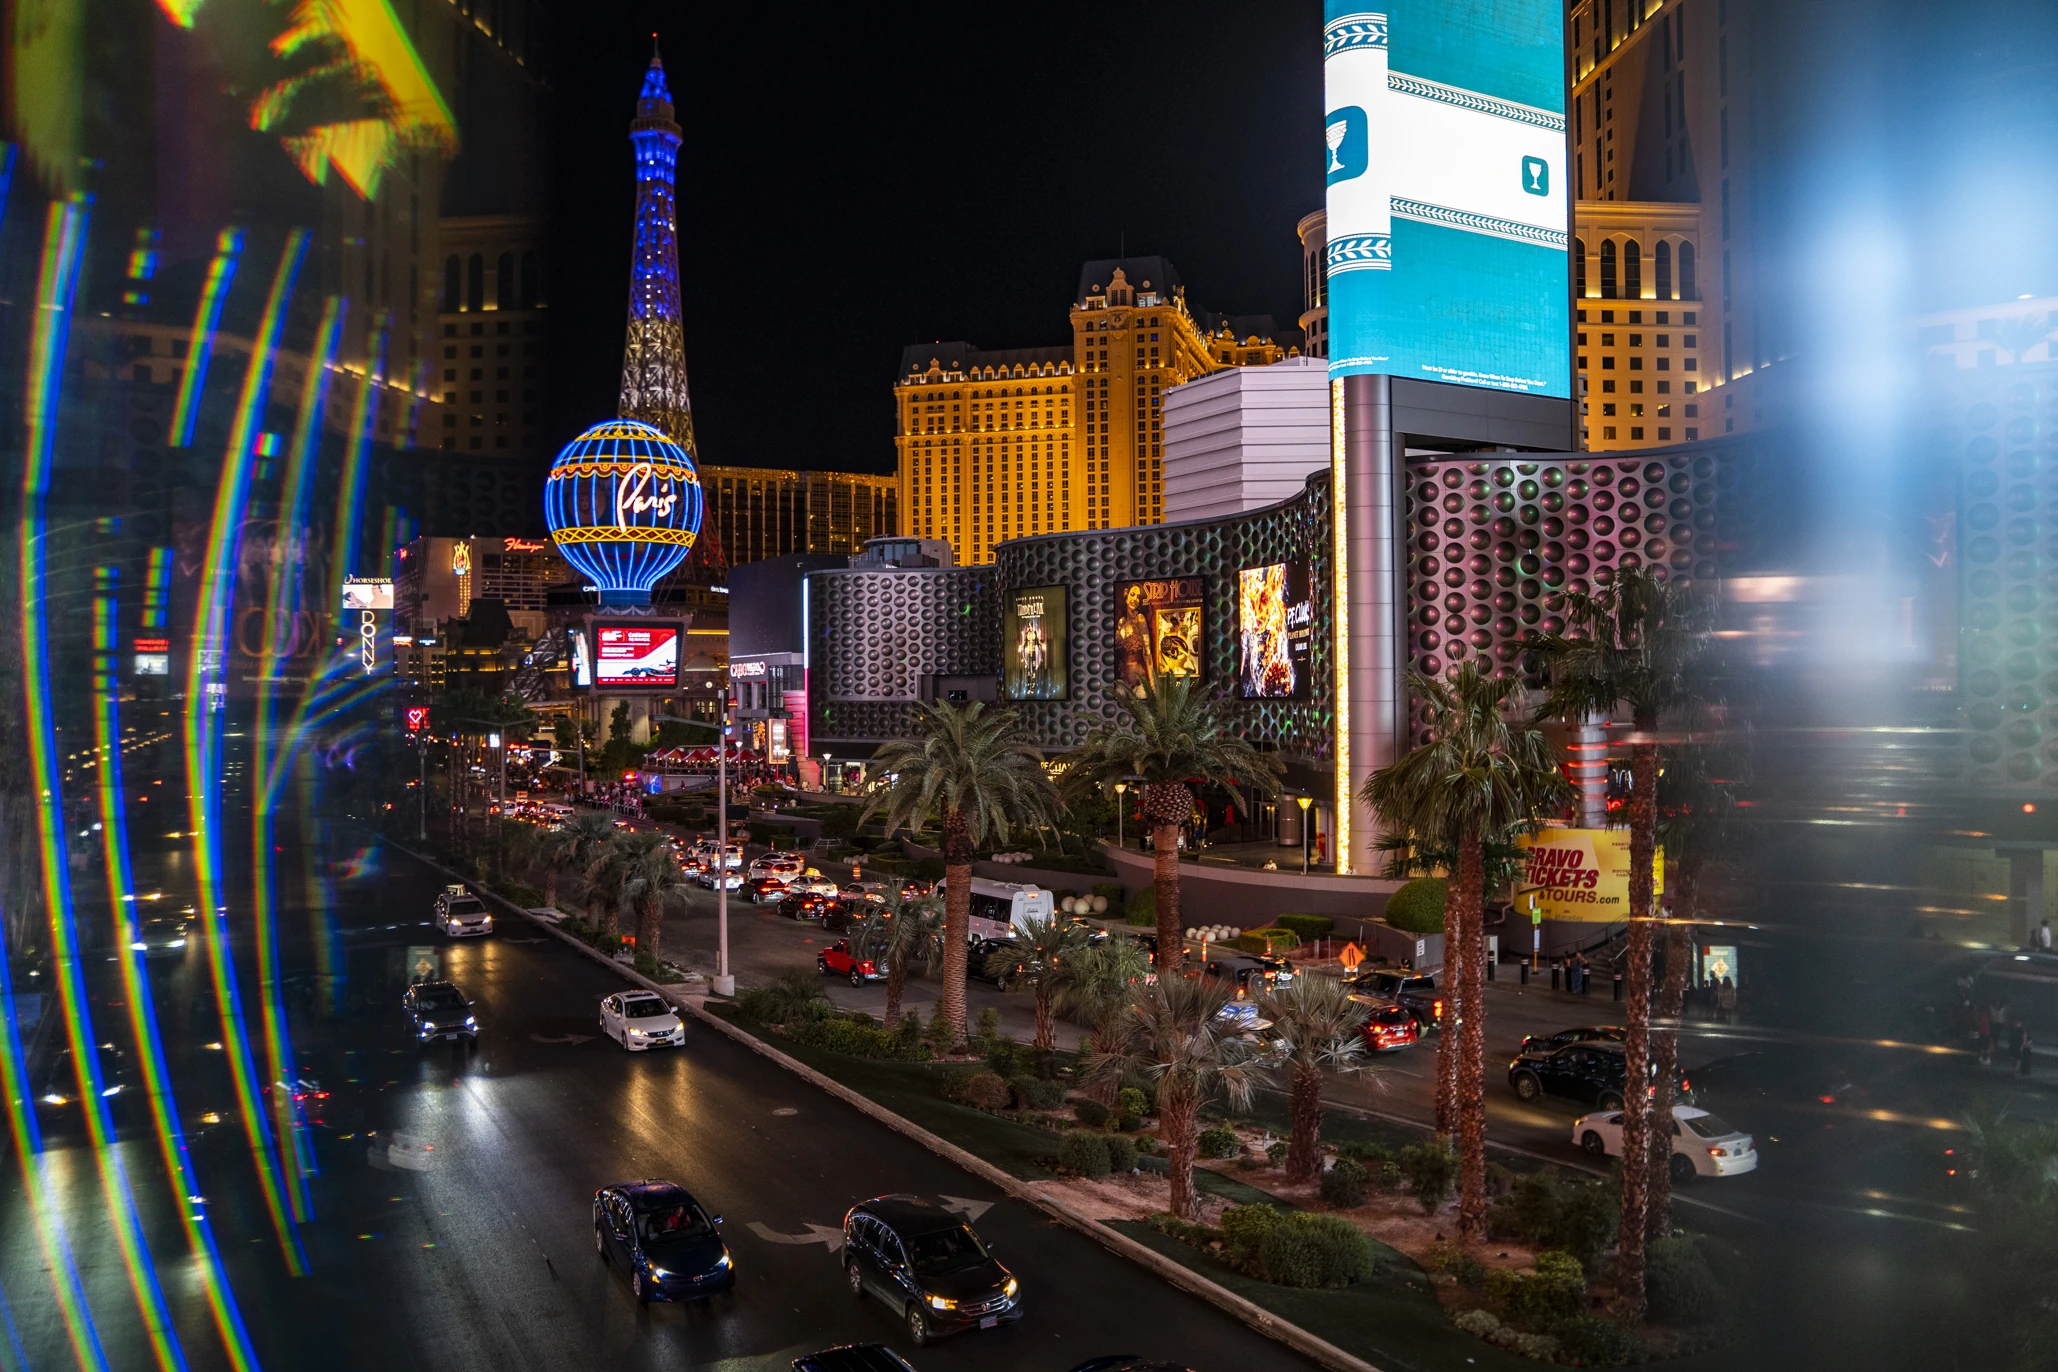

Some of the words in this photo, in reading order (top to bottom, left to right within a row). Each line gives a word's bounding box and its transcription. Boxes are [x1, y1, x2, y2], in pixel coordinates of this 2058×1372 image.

[617, 462, 677, 533] Paris
[504, 537, 544, 553] Flamingo
[1143, 581, 1169, 603] STRIP
[1170, 579, 1203, 603] HOUSE
[360, 610, 376, 675] DONNY
[1526, 846, 1583, 868] BRAVO
[1524, 865, 1599, 889] TICKETS
